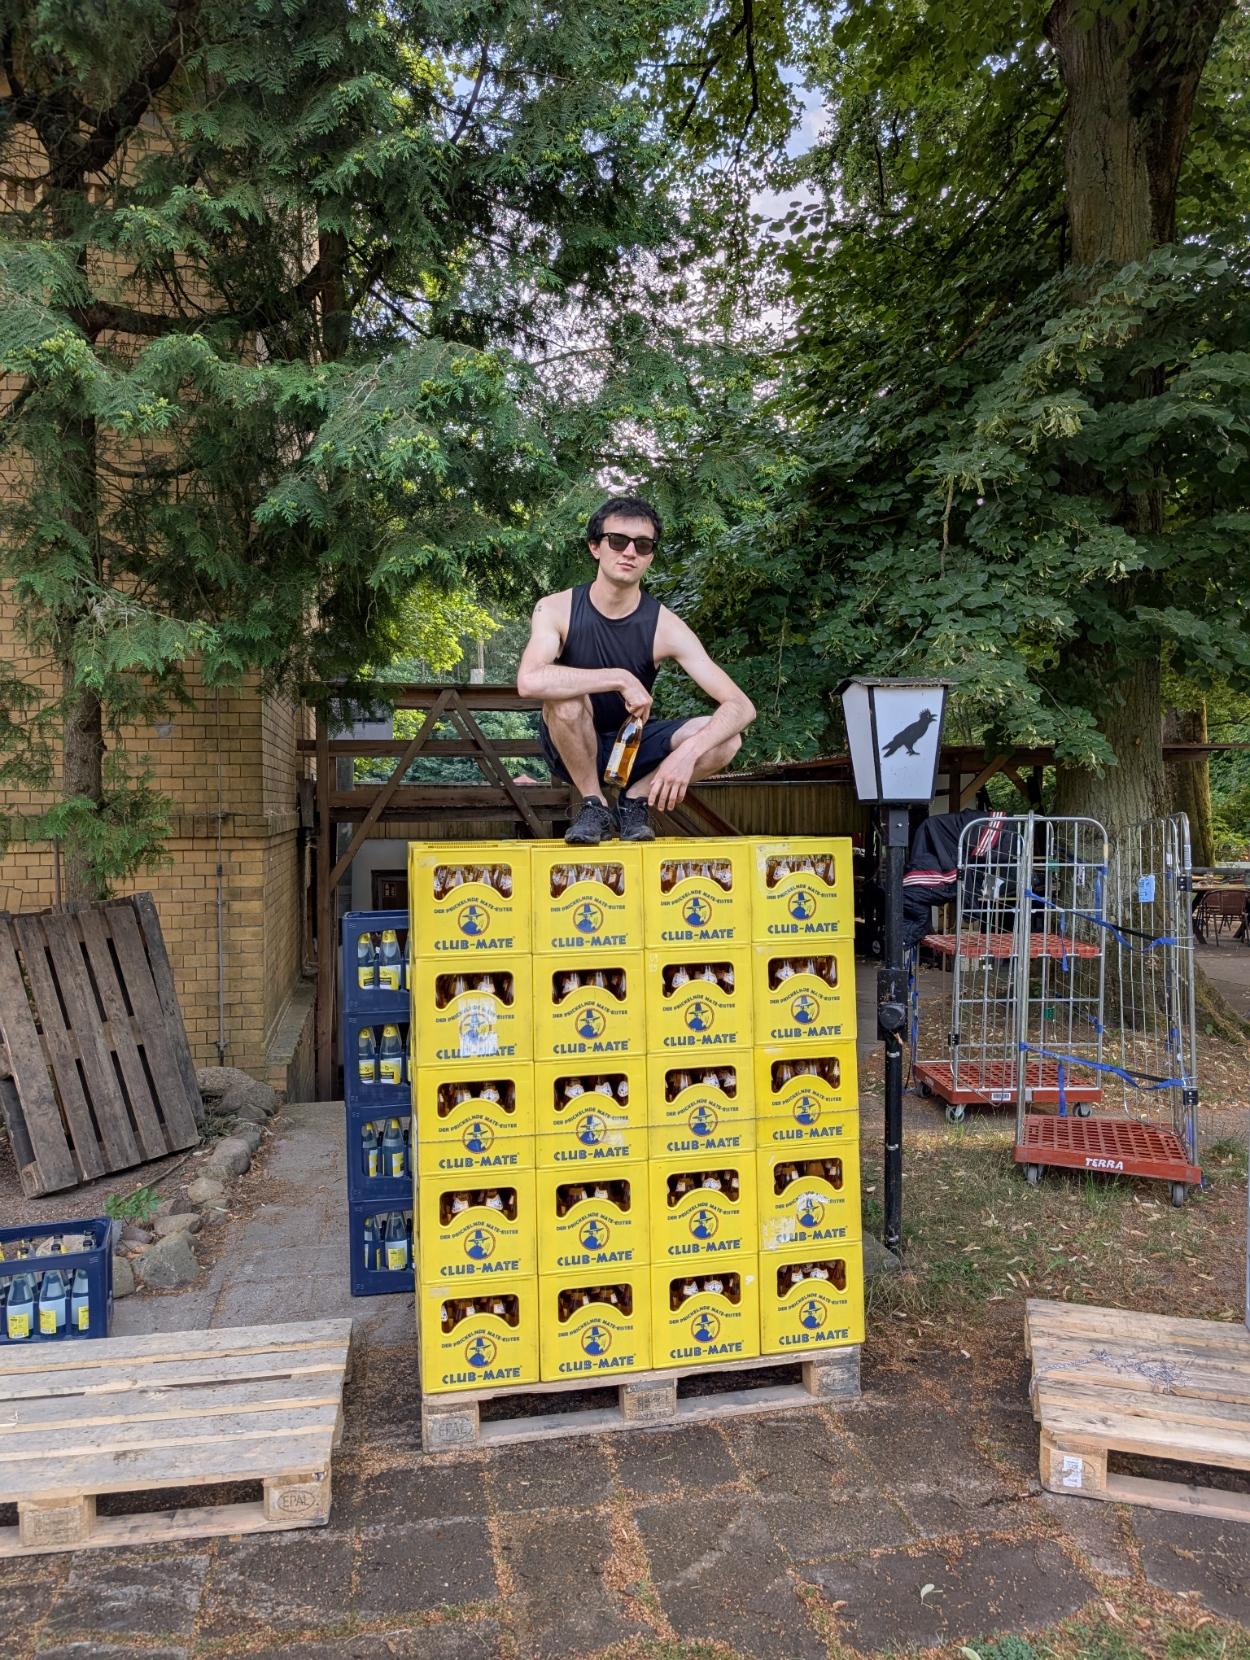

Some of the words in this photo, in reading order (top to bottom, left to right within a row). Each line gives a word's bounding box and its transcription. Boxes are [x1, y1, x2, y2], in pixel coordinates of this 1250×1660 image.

[661, 929, 735, 941] CLUB-MATE
[767, 923, 839, 934] CLUB-MATE
[434, 939, 514, 951] CLUB-MATE
[551, 936, 627, 948] CLUB-MATE
[771, 1026, 842, 1039] CLUB-MATE
[553, 1041, 629, 1054] CLUB-MATE
[664, 1034, 737, 1047] CLUB-MATE
[436, 1046, 516, 1060] CLUATE
[773, 1126, 843, 1141] CLUB-MATE
[667, 1137, 740, 1152] CLUB-MATE
[554, 1147, 630, 1161] CLUB-MATE
[439, 1155, 518, 1169] CLUB-MATE
[1085, 1157, 1124, 1170] TERRA
[668, 1240, 741, 1256] CLUB-MATE
[557, 1251, 633, 1267] CLUB-MATE
[440, 1261, 520, 1276] CLUB-MATE
[779, 1329, 849, 1346] CLUB-MATE
[670, 1342, 743, 1359] CLUB-MATE
[559, 1356, 634, 1373] CLUB-MATE
[442, 1368, 521, 1384] CLUB-MATE
[282, 1494, 310, 1508] EPAL
